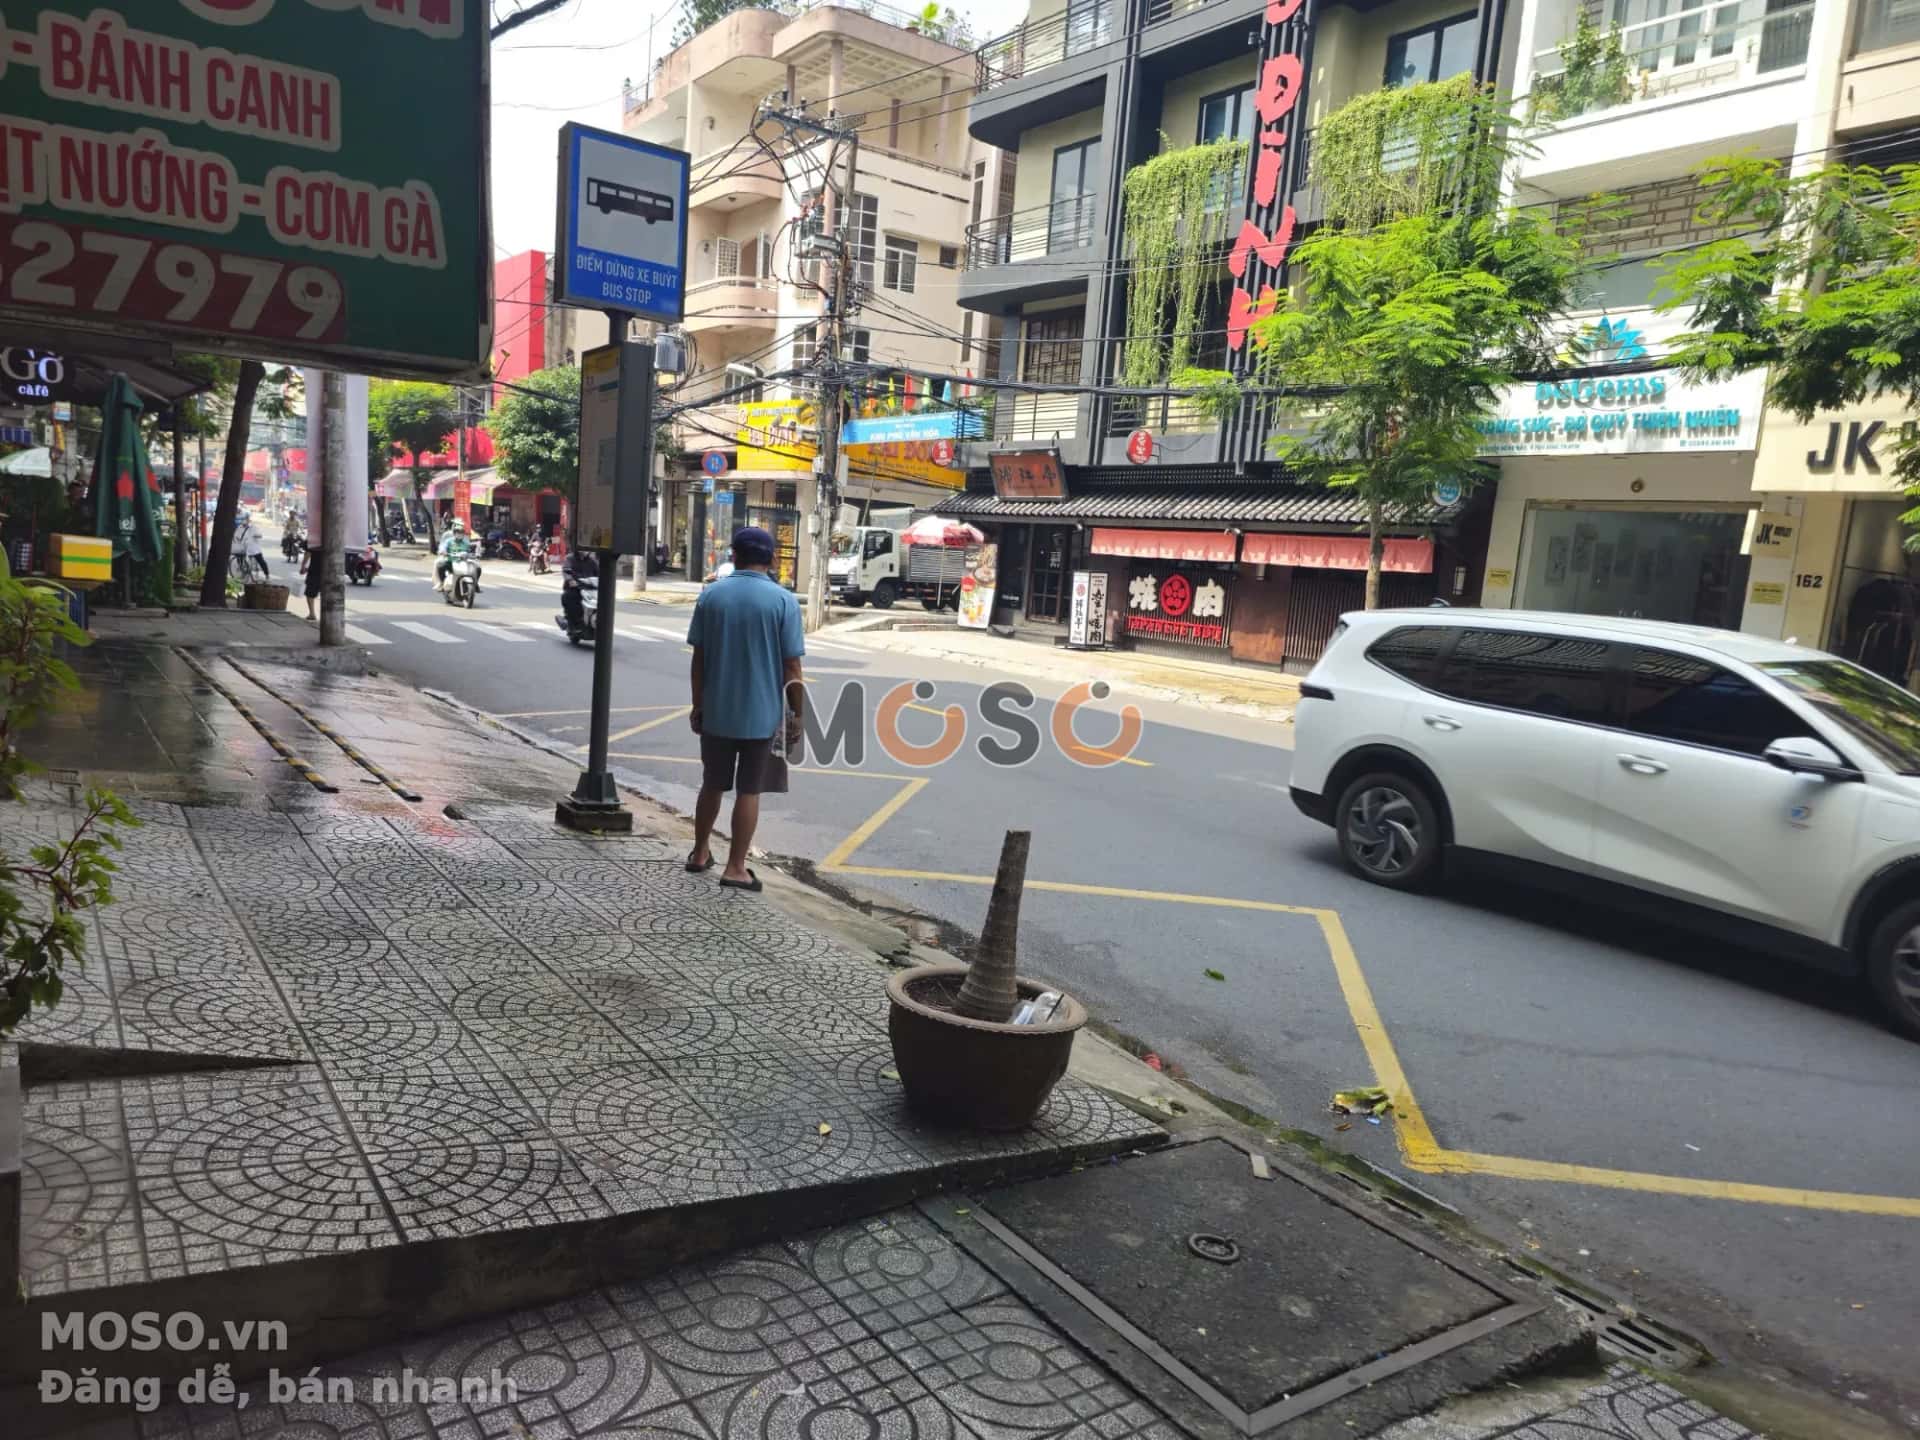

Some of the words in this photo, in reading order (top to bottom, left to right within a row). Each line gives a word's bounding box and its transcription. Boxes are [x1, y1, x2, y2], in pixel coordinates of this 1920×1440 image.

[51, 21, 191, 112] BÁNH
[206, 57, 331, 142] CANH
[59, 137, 228, 224] NƯỚNG
[275, 175, 370, 249] CƠM
[384, 188, 437, 260] GÀ
[0, 221, 342, 340] 27979
[577, 252, 602, 273] ĐIỂM
[606, 259, 634, 280] DỪNG
[637, 268, 650, 283] XE
[653, 270, 678, 289] BUÝT
[602, 281, 623, 299] BUS
[625, 286, 652, 305] STOP
[1807, 420, 1886, 473] JK
[1755, 523, 1774, 545] JK
[1796, 574, 1823, 588] 162
